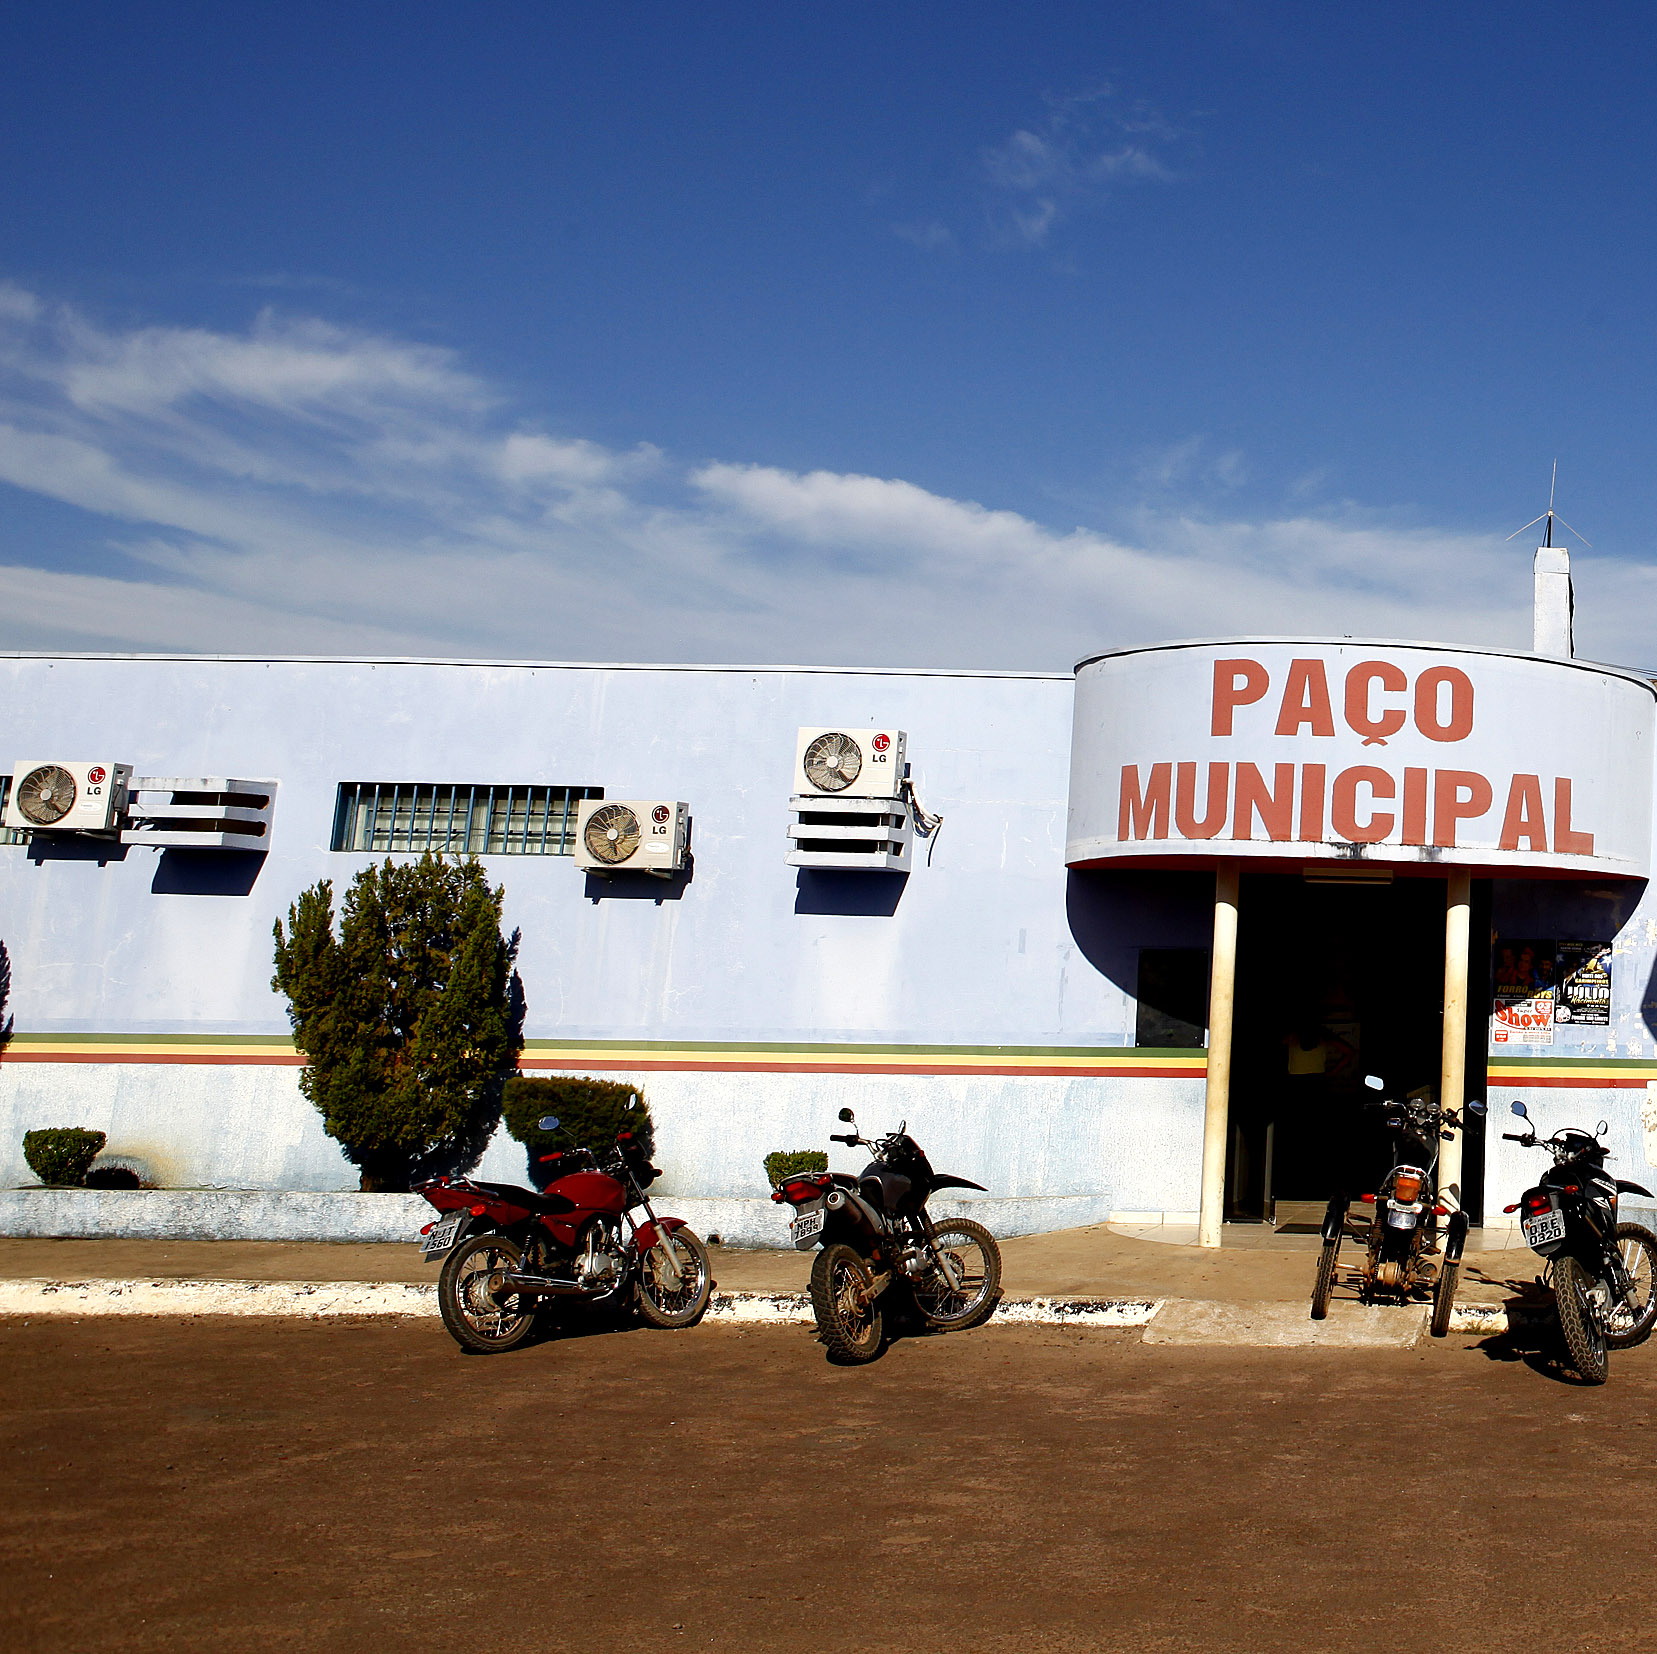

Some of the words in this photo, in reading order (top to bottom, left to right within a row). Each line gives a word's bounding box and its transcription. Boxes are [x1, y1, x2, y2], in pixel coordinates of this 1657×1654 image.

[1210, 658, 1475, 747] PAÇO
[872, 754, 887, 763] LG
[87, 786, 102, 795] LG
[1117, 761, 1595, 856] MUNICIPAL
[652, 826, 667, 835] LG
[1495, 1000, 1551, 1027] Show
[797, 1218, 816, 1231] NPH
[1530, 1228, 1562, 1245] 0320
